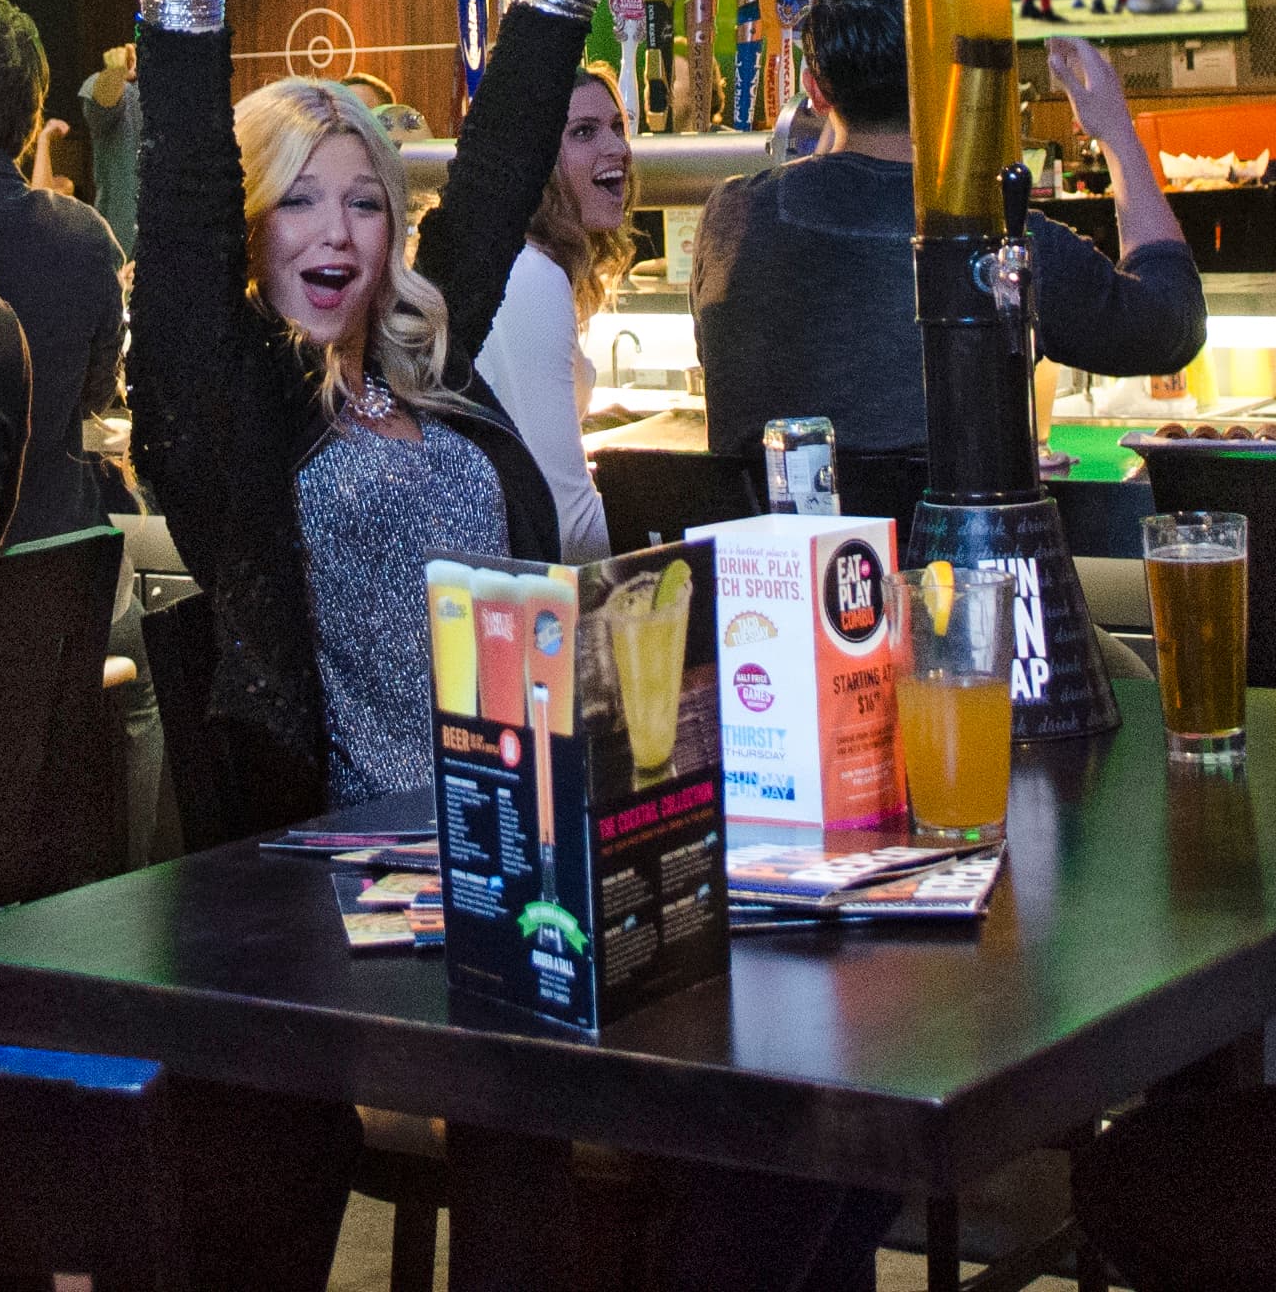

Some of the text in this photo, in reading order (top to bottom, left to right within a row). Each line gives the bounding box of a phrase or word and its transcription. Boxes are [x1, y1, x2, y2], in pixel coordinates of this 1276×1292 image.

[719, 556, 804, 579] DRINK. PLAY.
[836, 554, 863, 585] EAT
[745, 578, 805, 601] SPORTS.
[839, 579, 873, 611] PLAY
[840, 607, 875, 632] COMBO
[832, 667, 880, 695] STARTING
[441, 724, 471, 753] BEER
[722, 747, 787, 760] THURSDAY
